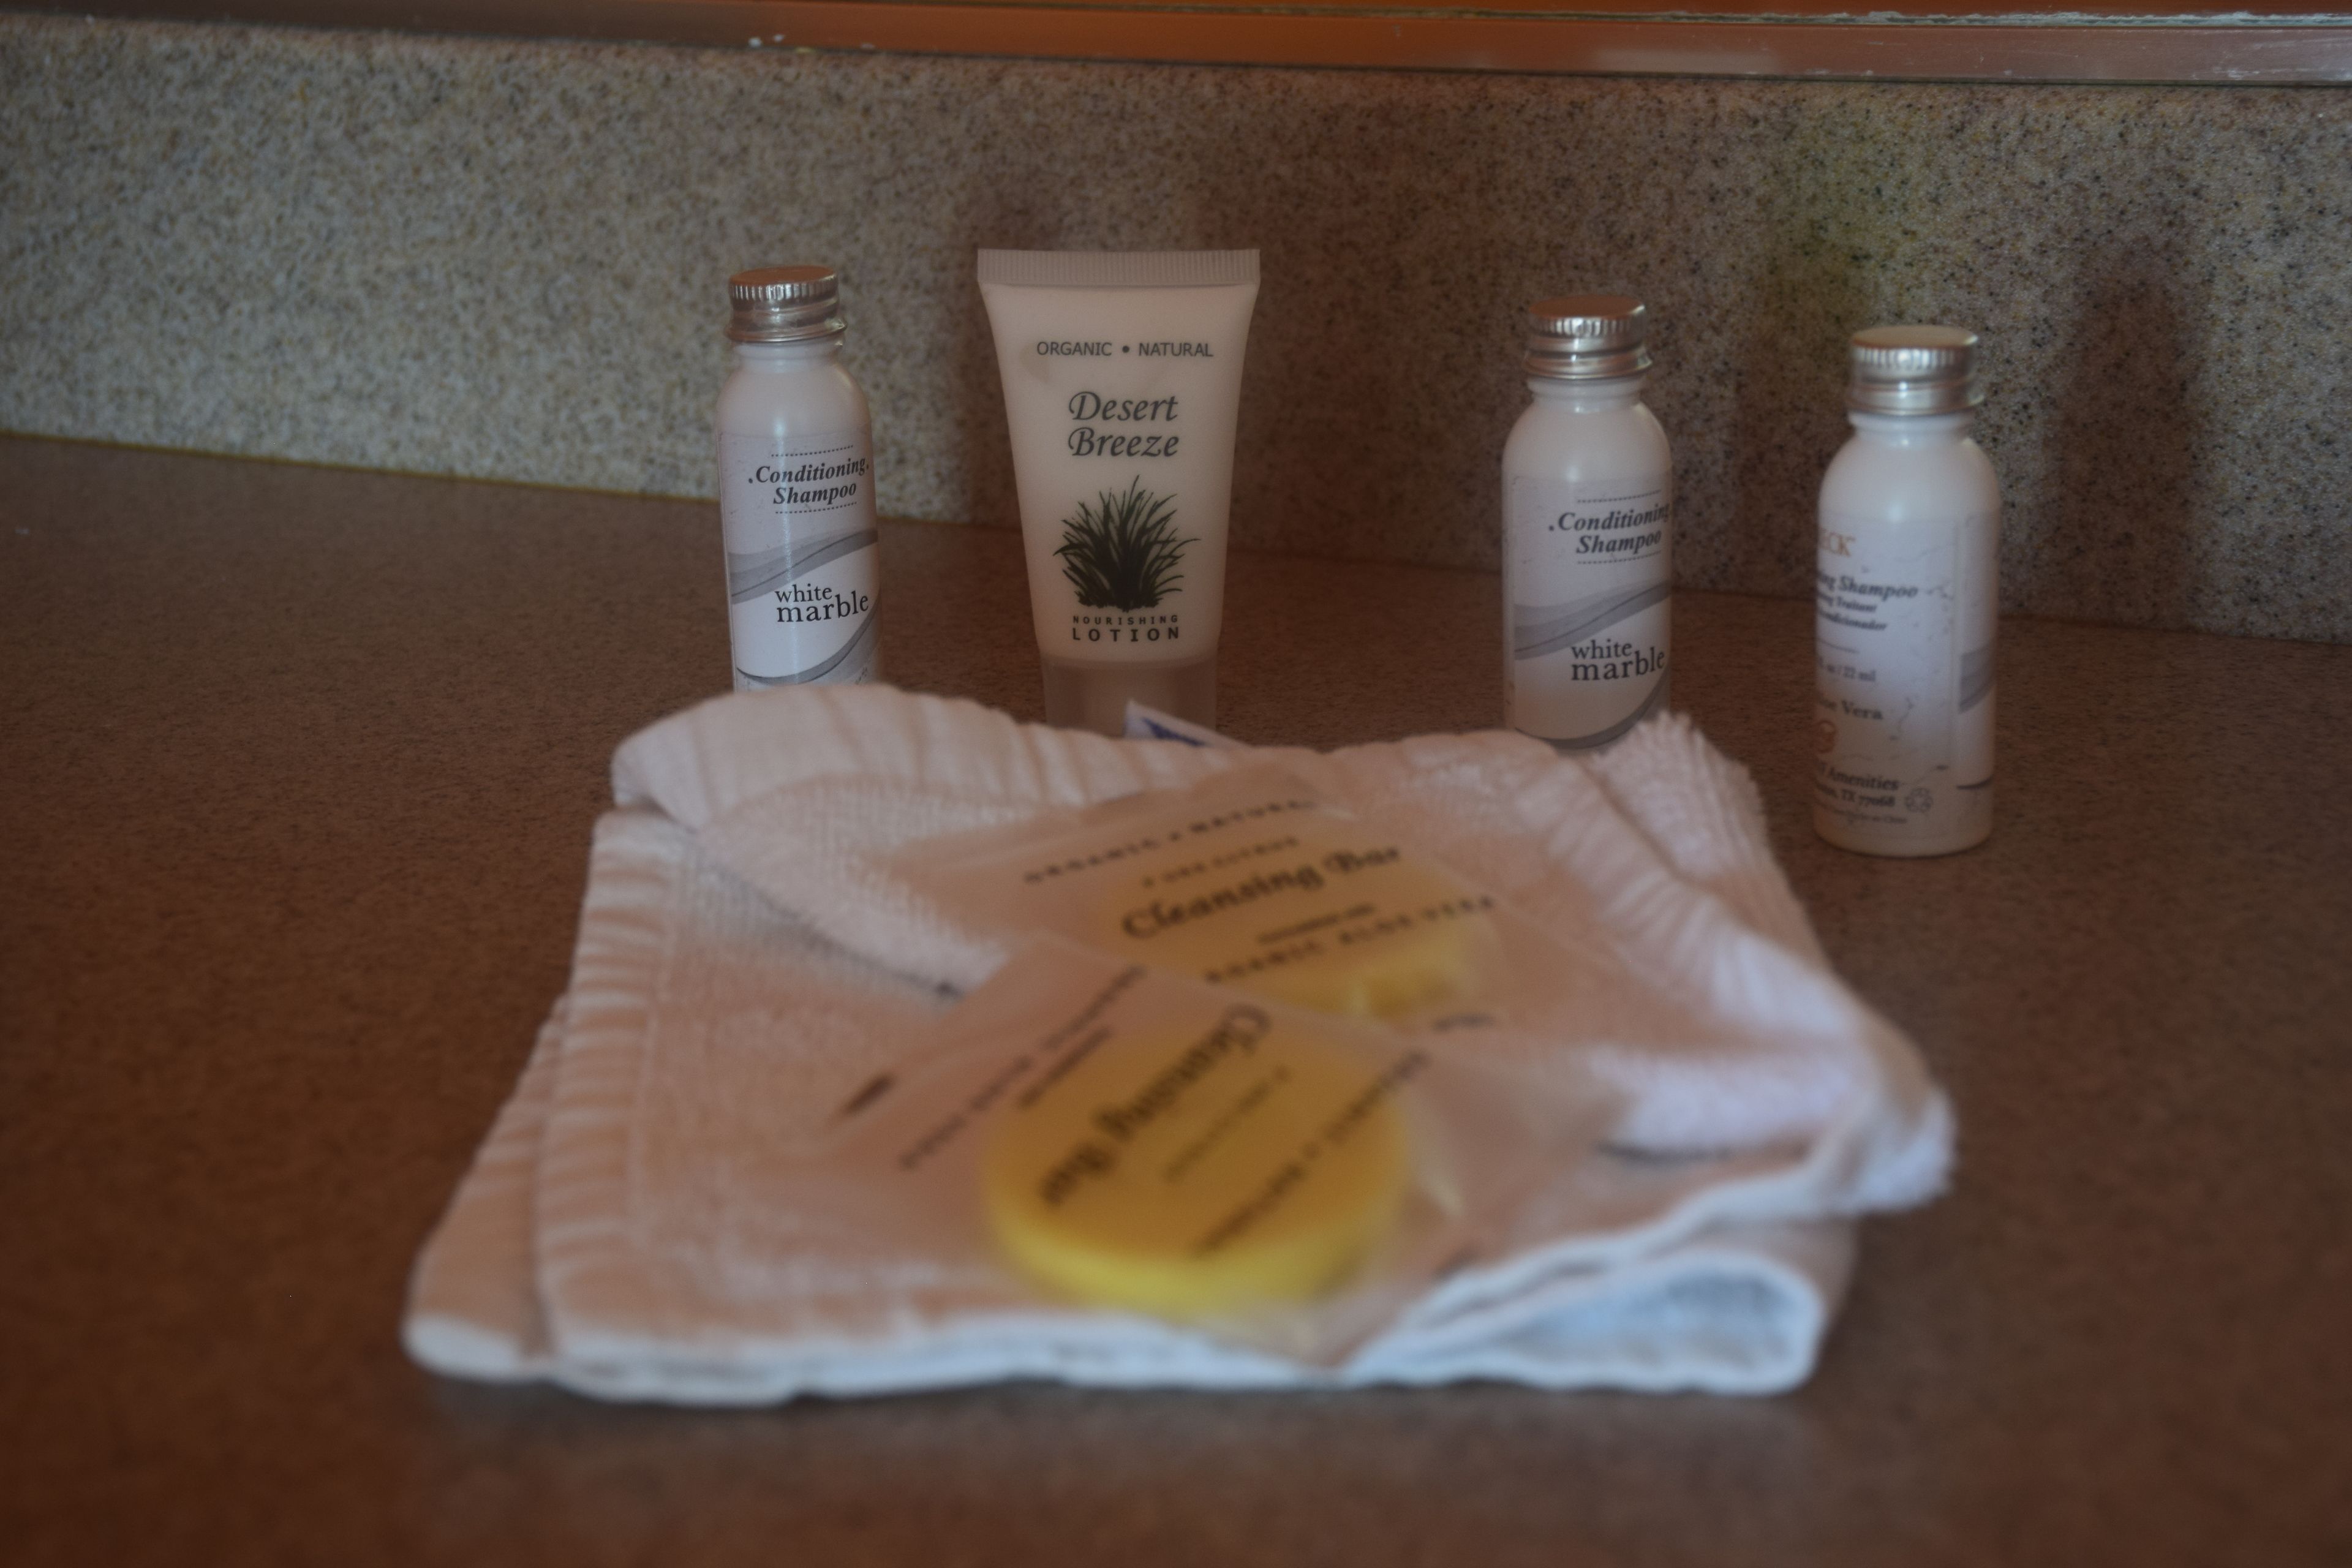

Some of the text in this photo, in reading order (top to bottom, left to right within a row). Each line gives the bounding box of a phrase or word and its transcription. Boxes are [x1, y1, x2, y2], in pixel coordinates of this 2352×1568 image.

[1036, 341, 1213, 357] ORGANIC NATURAL
[1068, 391, 1178, 421] Desert
[1068, 426, 1180, 457] Breeze
[773, 482, 857, 505] Shampoo
[1577, 530, 1661, 554] Shampoo
[774, 582, 833, 603] white
[1839, 575, 1919, 601] Shampoo
[776, 590, 869, 622] marble
[1072, 615, 1178, 625] NOURISHING
[1072, 627, 1178, 642] LOTION
[1571, 639, 1632, 660] white
[1571, 647, 1665, 680] marble
[1120, 863, 1326, 940] Cleansing
[1321, 845, 1401, 875] Bar
